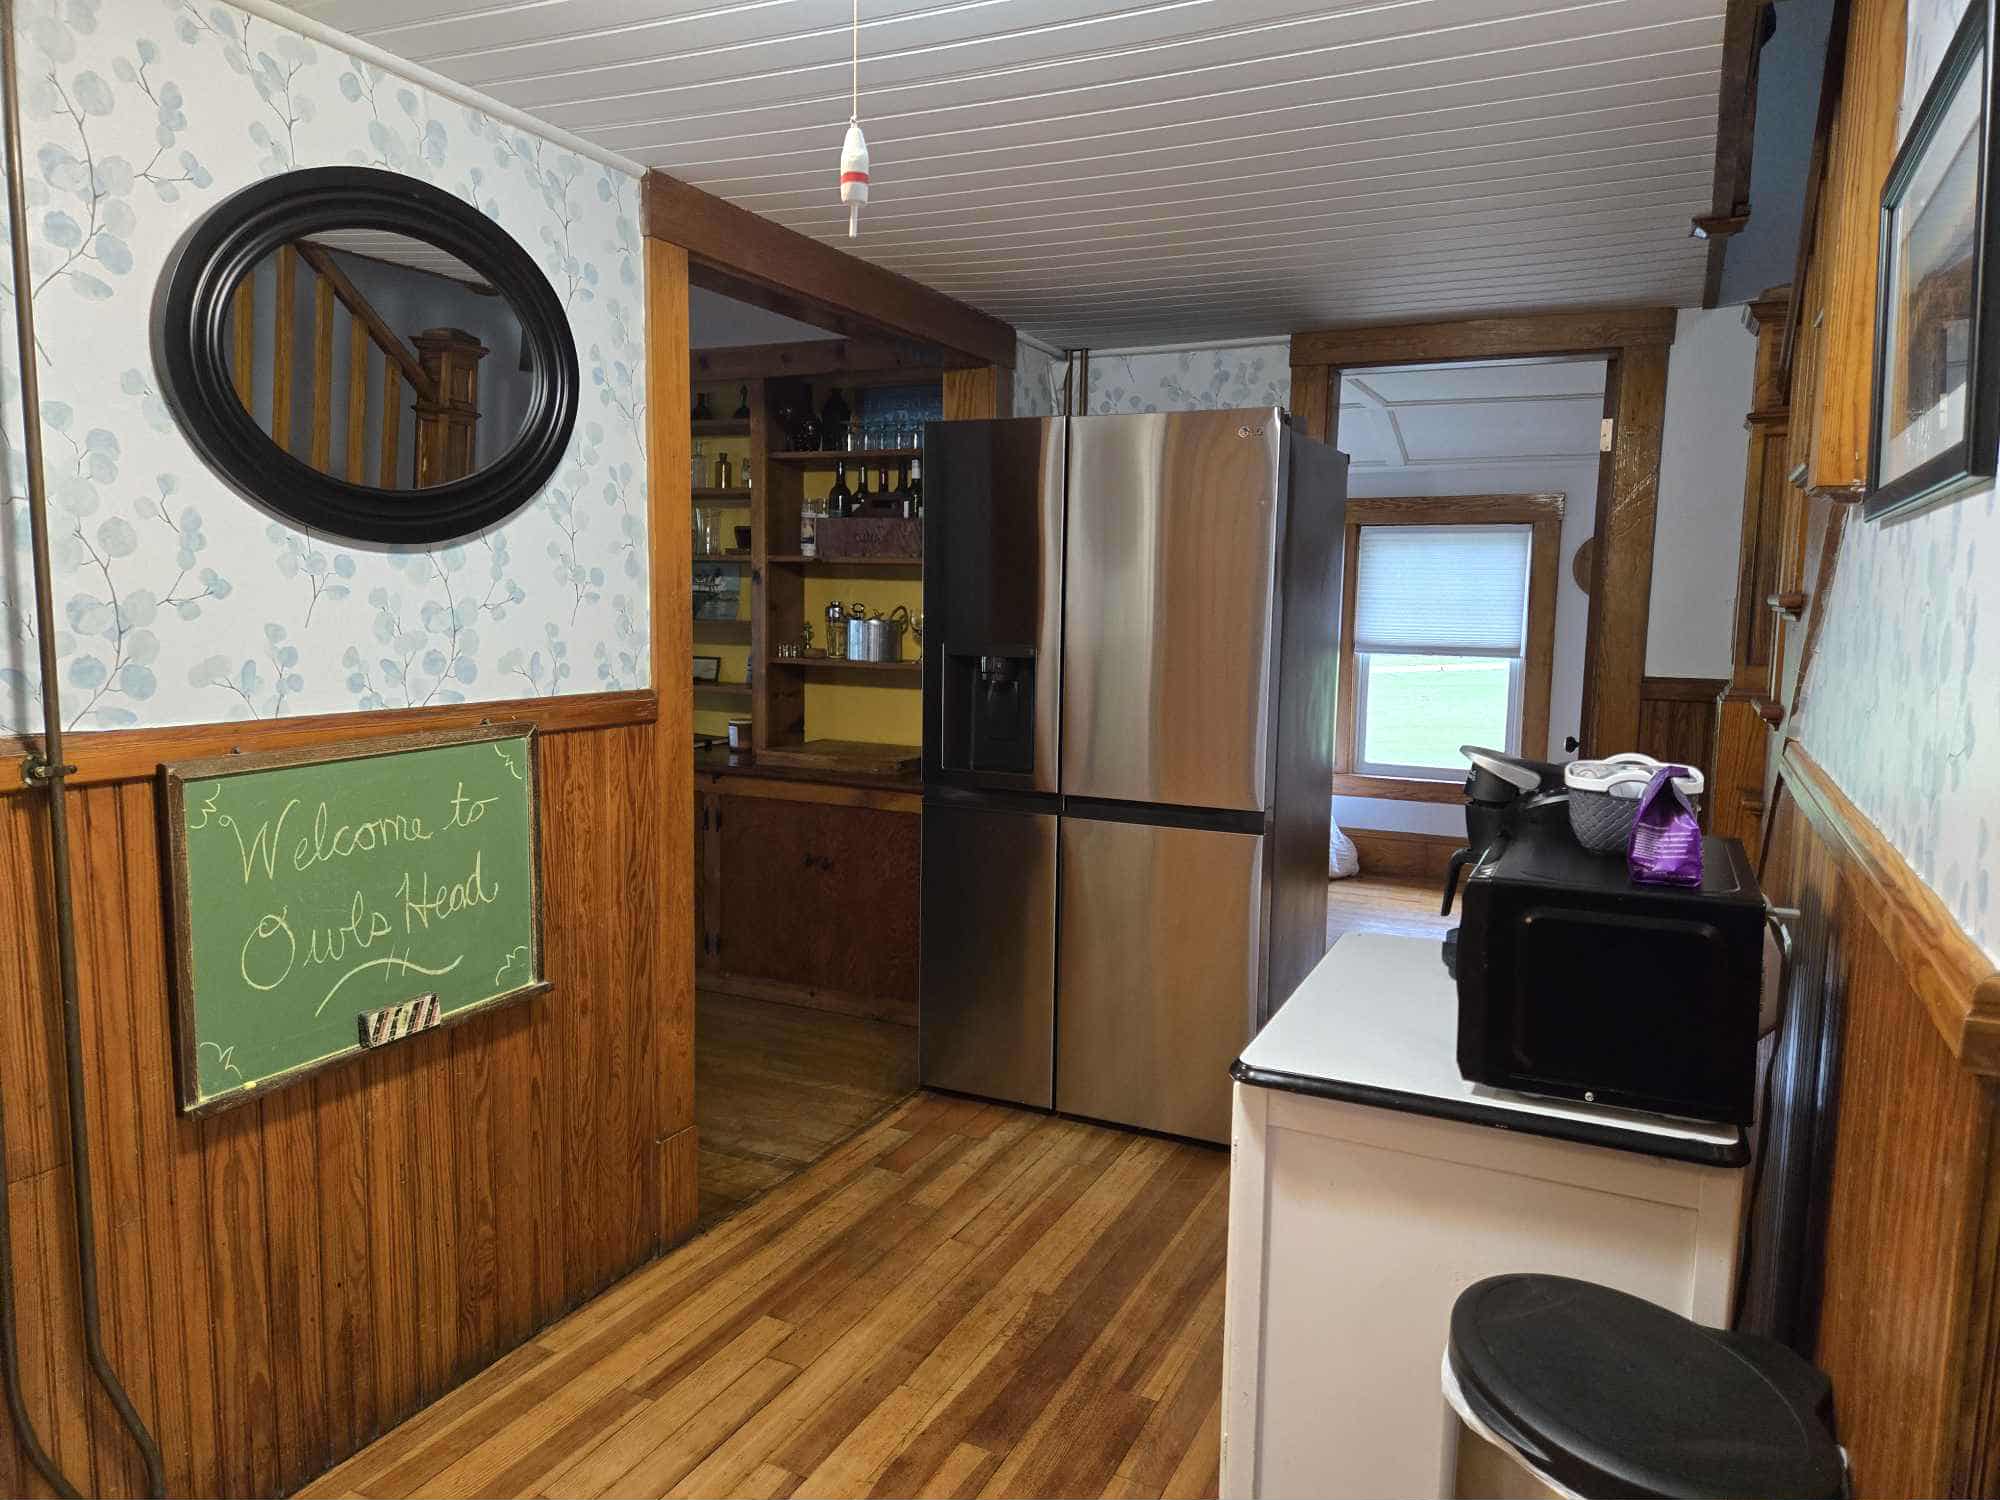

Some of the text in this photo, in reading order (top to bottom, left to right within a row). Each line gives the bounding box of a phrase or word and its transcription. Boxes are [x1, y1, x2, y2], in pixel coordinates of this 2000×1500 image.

[218, 781, 499, 885] Welcome to
[240, 849, 499, 991] Owls Head
